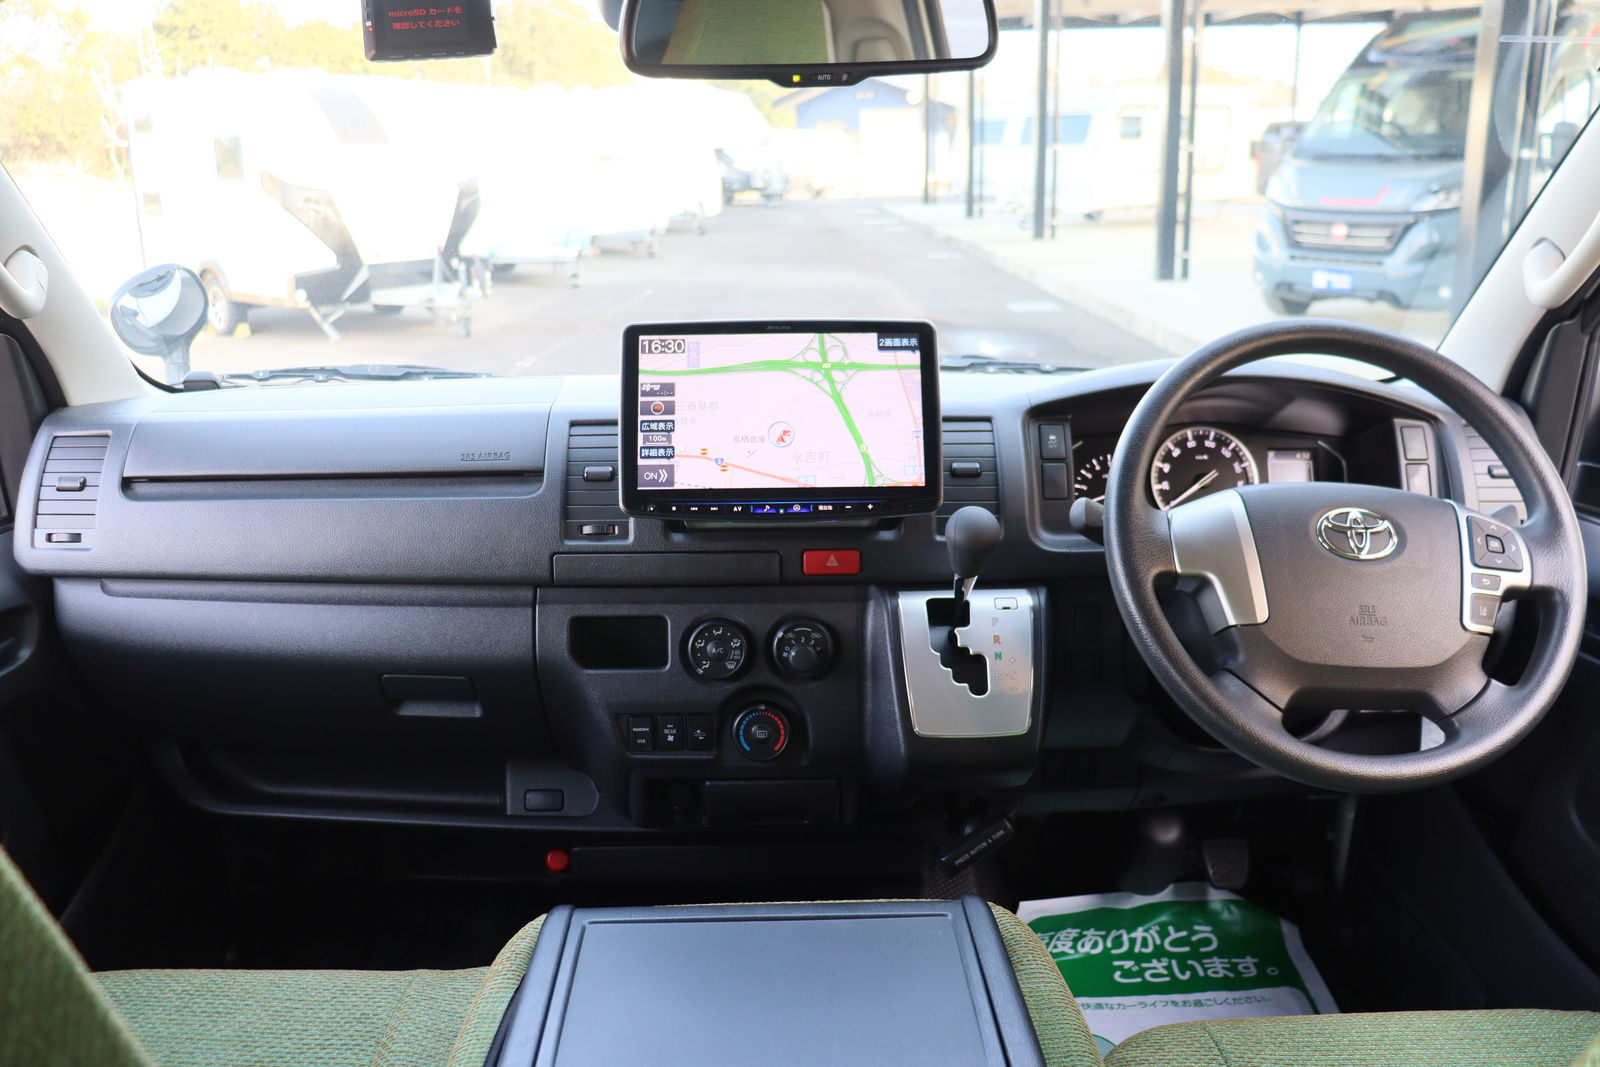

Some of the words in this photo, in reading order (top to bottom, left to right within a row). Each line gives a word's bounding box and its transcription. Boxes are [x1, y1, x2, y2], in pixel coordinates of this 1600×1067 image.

[388, 8, 426, 17] microSD
[428, 6, 463, 16] カードを
[392, 19, 460, 30] 確認してください
[642, 340, 685, 354] 16:30
[879, 337, 918, 347] 2画面表示
[641, 422, 674, 431] 広域表示
[478, 451, 511, 460] AIRBAG
[641, 448, 674, 458] 詳細表示
[791, 450, 830, 463] 永吉町
[643, 472, 658, 481] ON
[1490, 540, 1500, 548] OK
[1358, 604, 1376, 614] SRS
[991, 617, 999, 626] P
[1349, 616, 1388, 627] AIRBAG
[993, 635, 1001, 645] R
[994, 651, 1002, 660] N
[954, 853, 970, 866] PRESS
[969, 841, 988, 856] BUTTON
[991, 829, 1005, 841] TURN
[1112, 956, 1279, 983] ございます。
[1078, 995, 1270, 1011] 快適なカーライフをお過ごしください。
